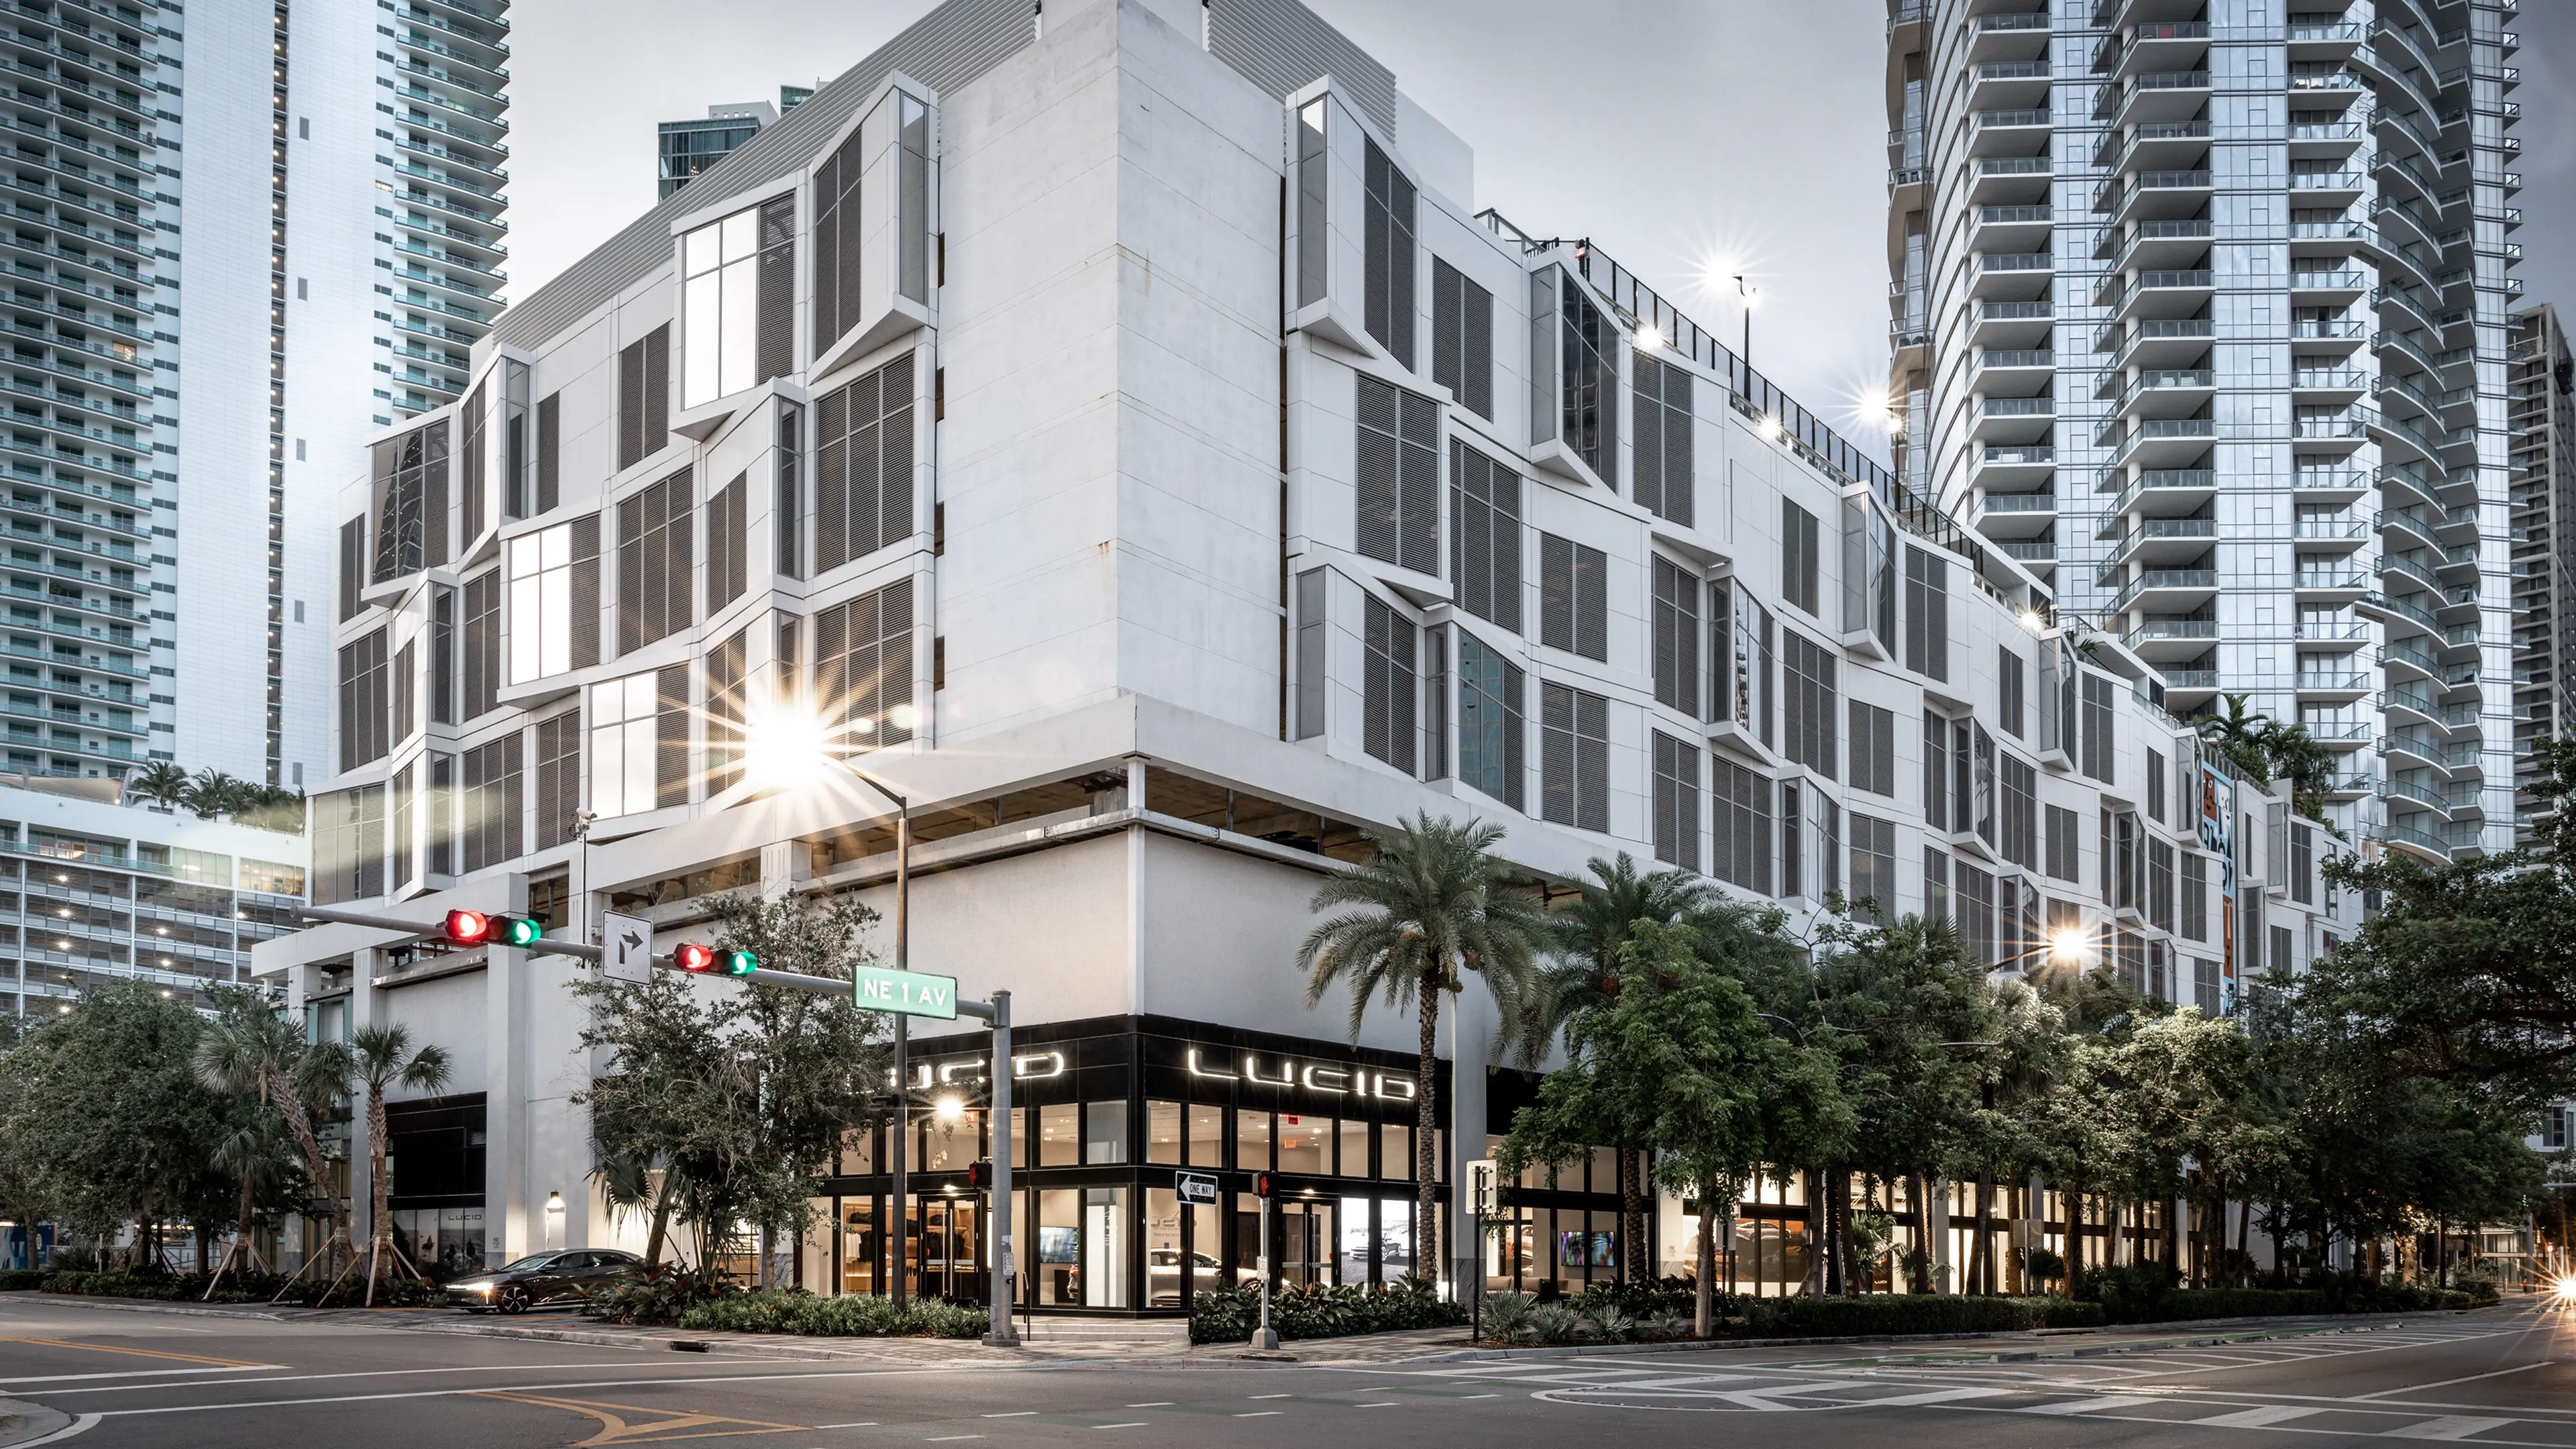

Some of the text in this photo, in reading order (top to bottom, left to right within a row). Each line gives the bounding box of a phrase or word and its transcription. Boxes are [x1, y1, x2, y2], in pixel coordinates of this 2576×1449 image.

[864, 978, 947, 1006] NE 1 AV
[1188, 1049, 1415, 1101] LUCID
[1189, 1183, 1212, 1195] ONE WAY
